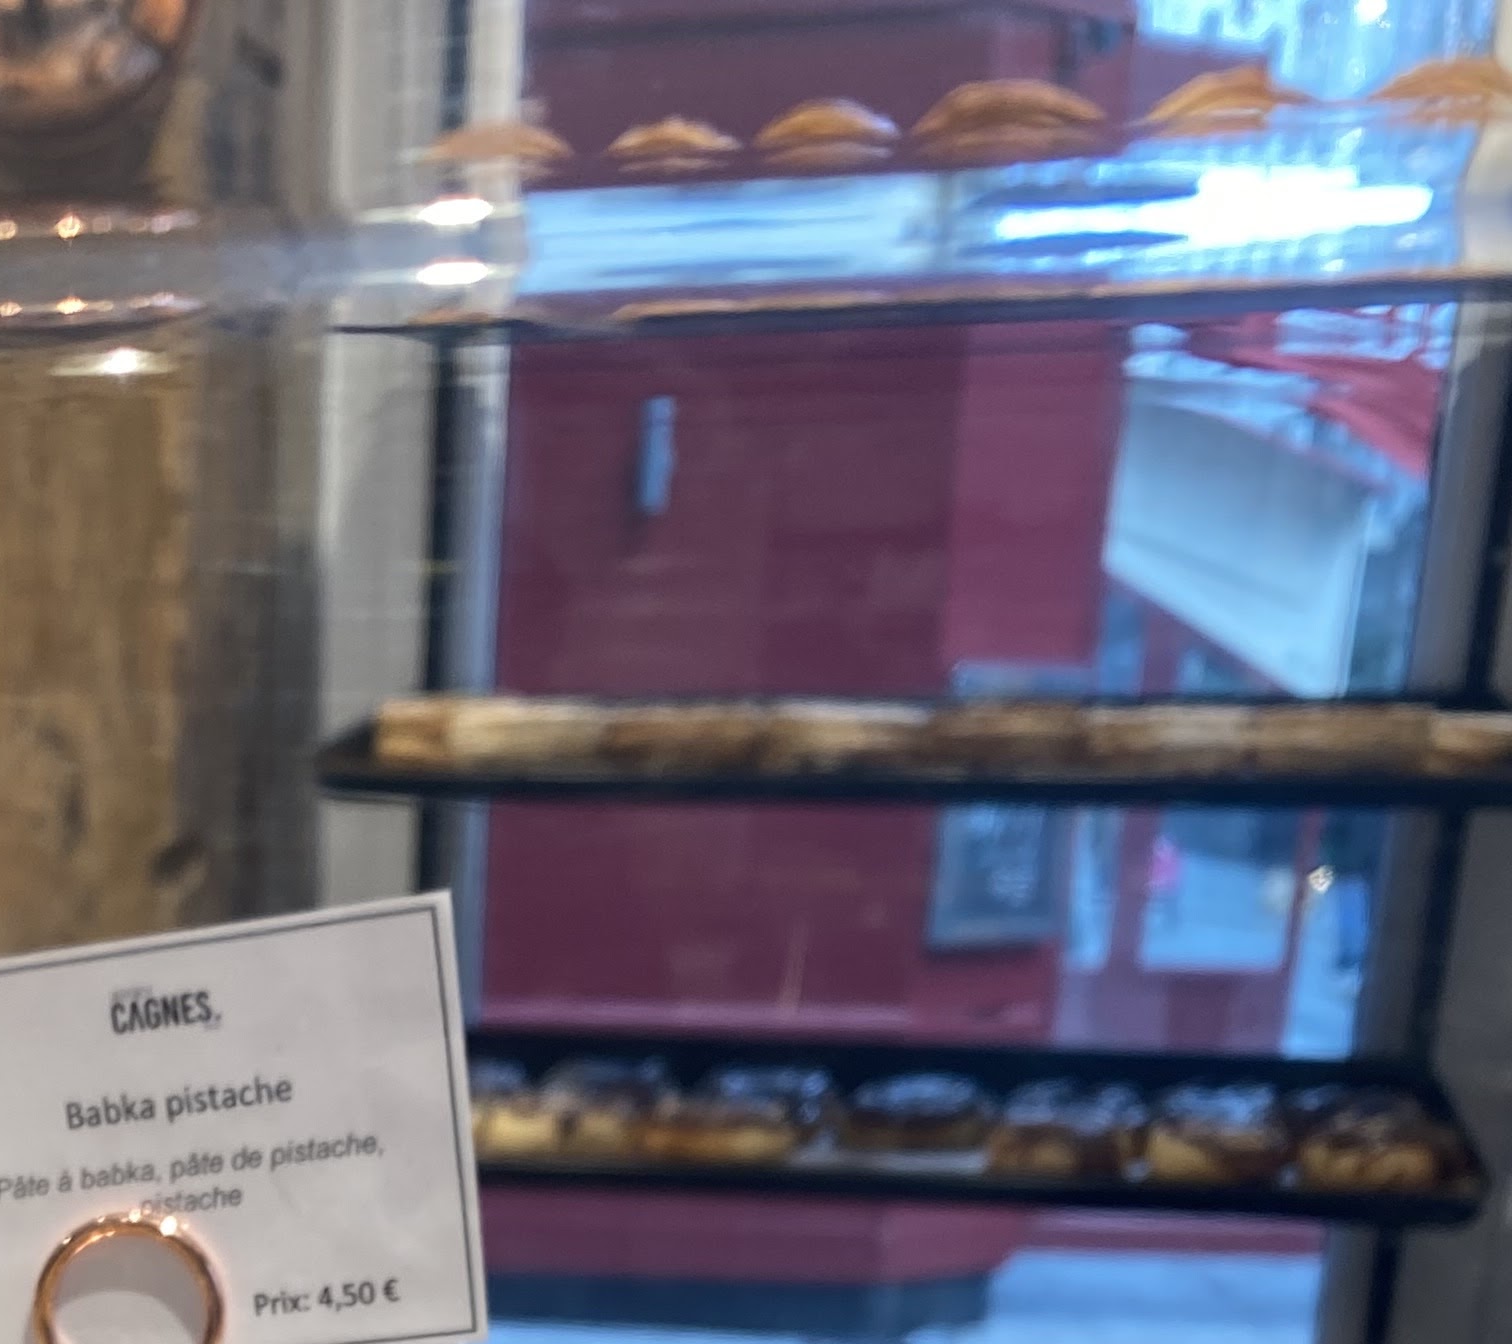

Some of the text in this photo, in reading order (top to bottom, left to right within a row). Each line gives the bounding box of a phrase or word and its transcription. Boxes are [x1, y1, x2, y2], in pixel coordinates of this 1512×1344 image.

[65, 1076, 292, 1130] Babka pistache
[57, 1172, 71, 1193] à
[80, 1161, 161, 1190] babka,
[169, 1150, 223, 1184] pâte
[232, 1146, 262, 1170] de
[269, 1133, 385, 1171] pistache,
[253, 1279, 400, 1317] Prix: 4,50 €
